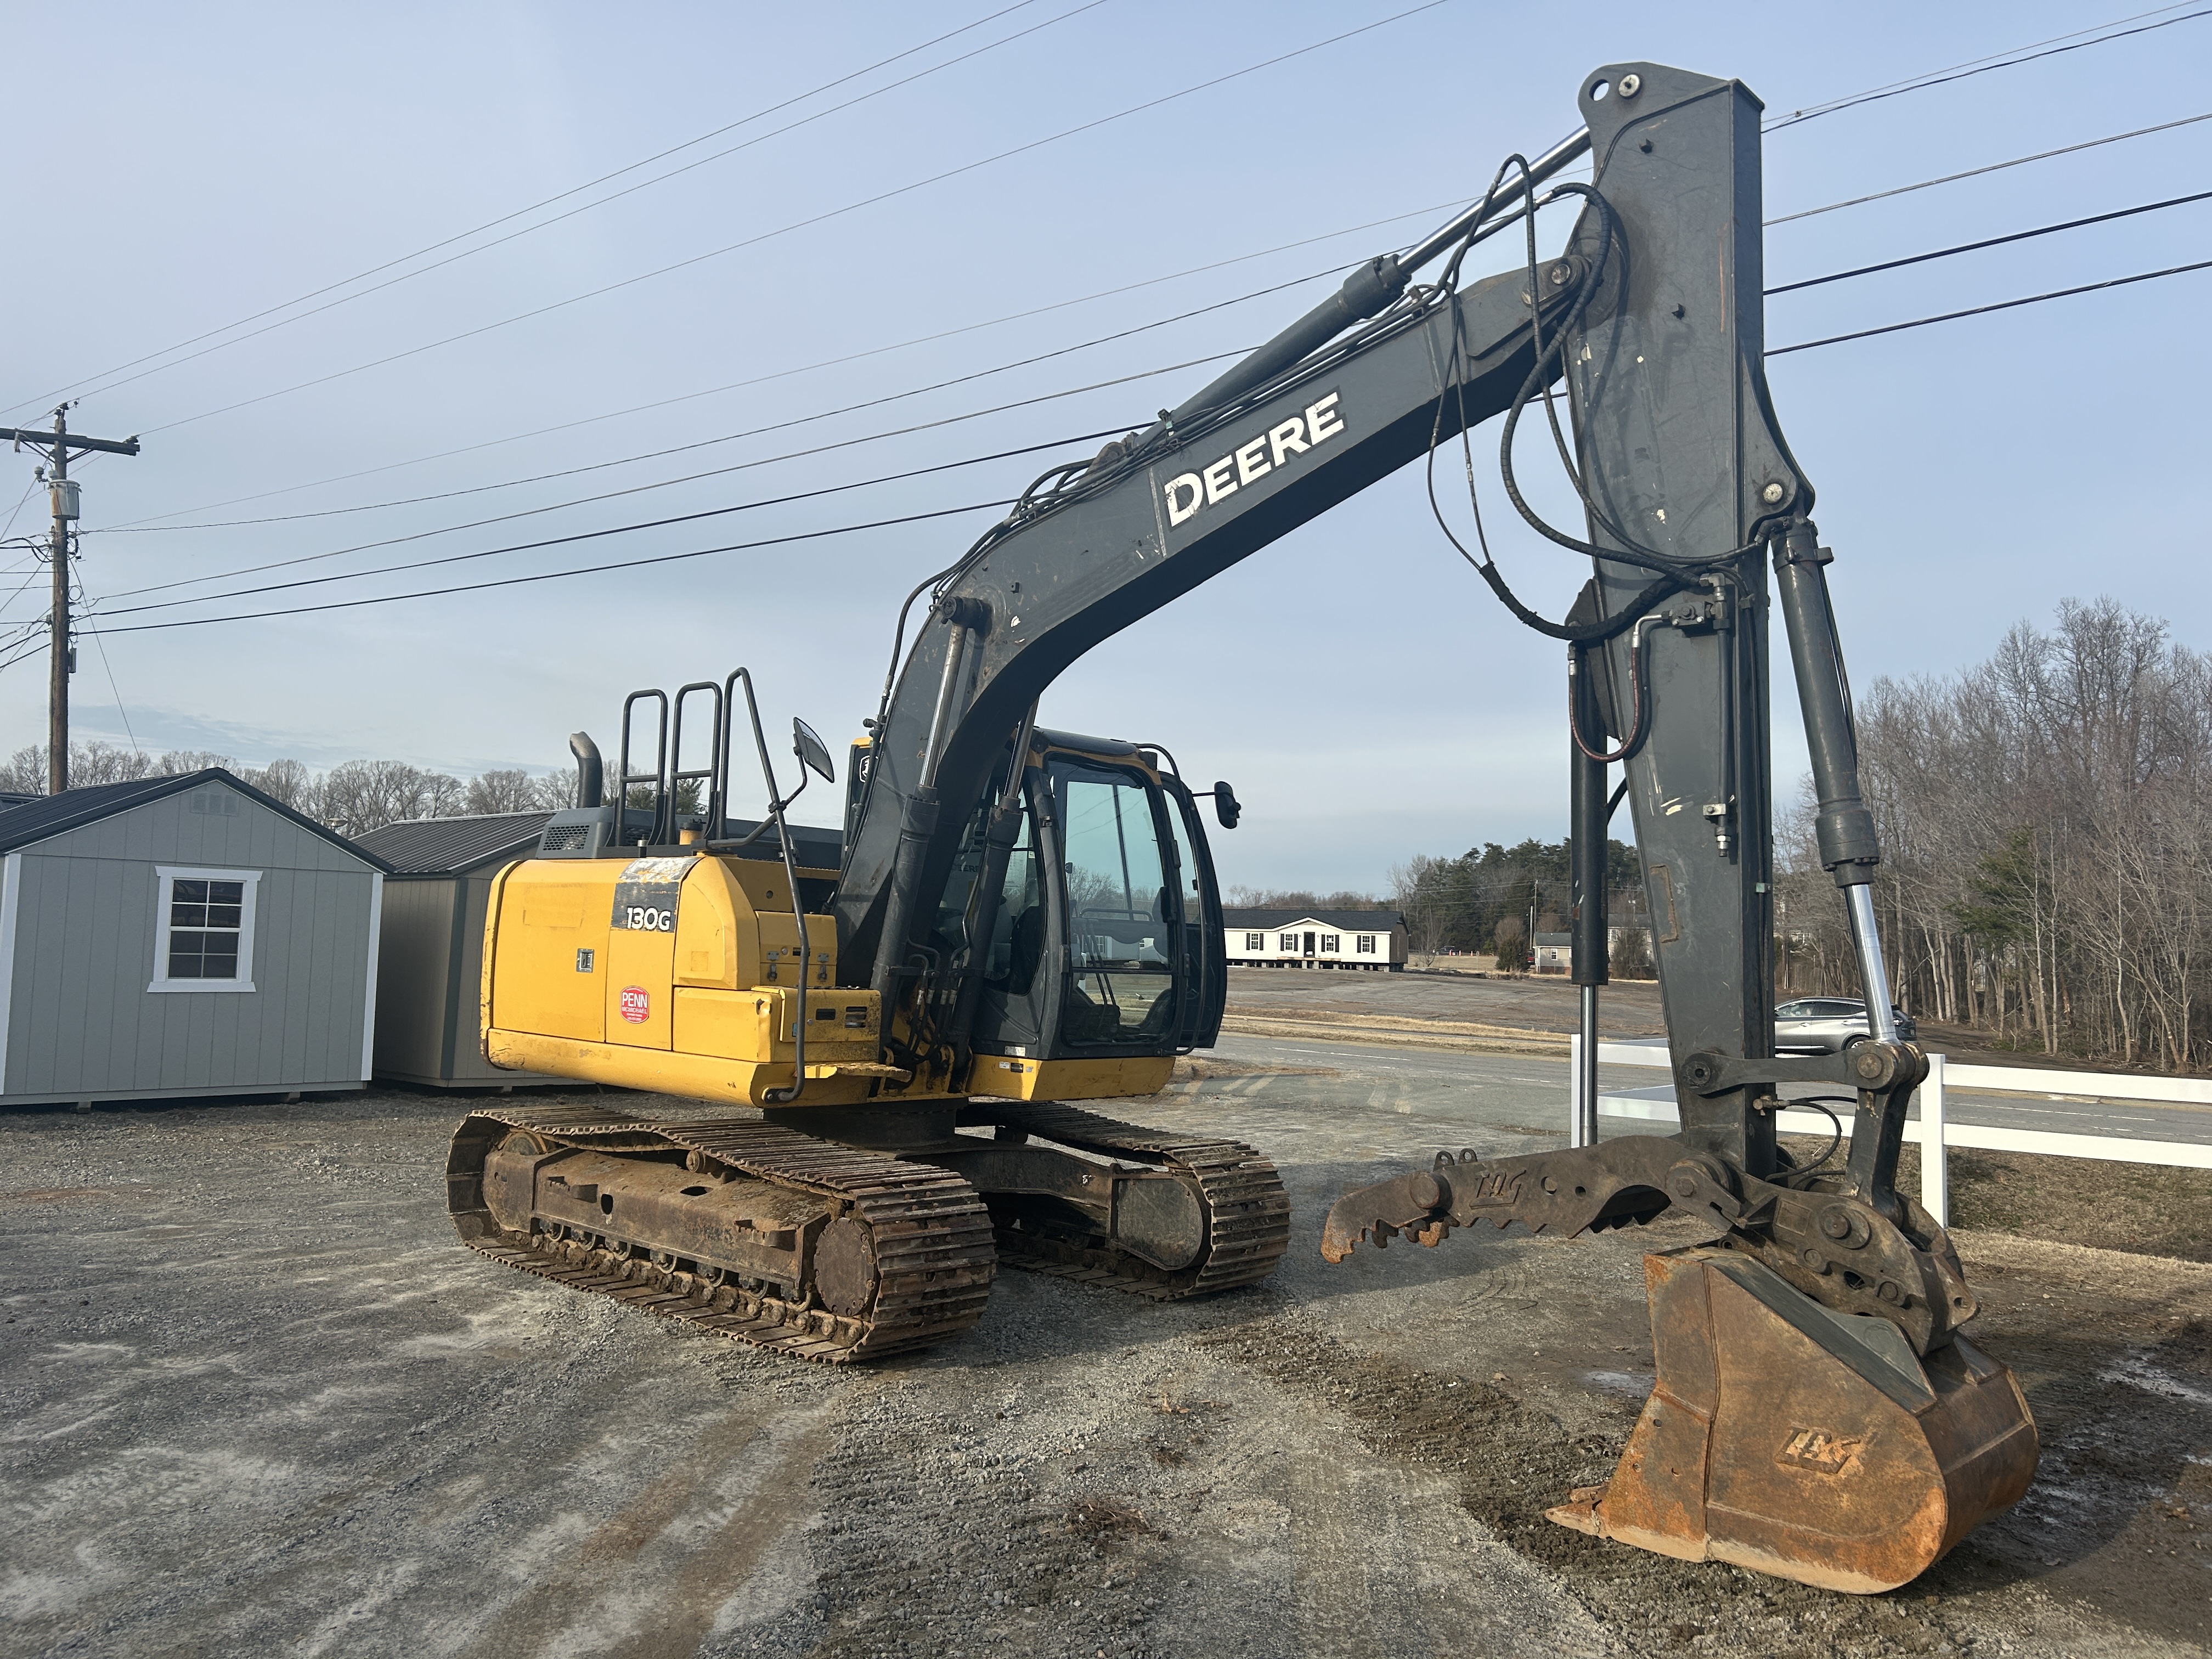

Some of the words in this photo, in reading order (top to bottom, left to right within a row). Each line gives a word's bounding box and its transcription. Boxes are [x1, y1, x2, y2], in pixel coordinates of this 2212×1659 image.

[1164, 392, 1345, 527] DEERE
[627, 907, 671, 931] 130G
[622, 992, 647, 1008] PENN
